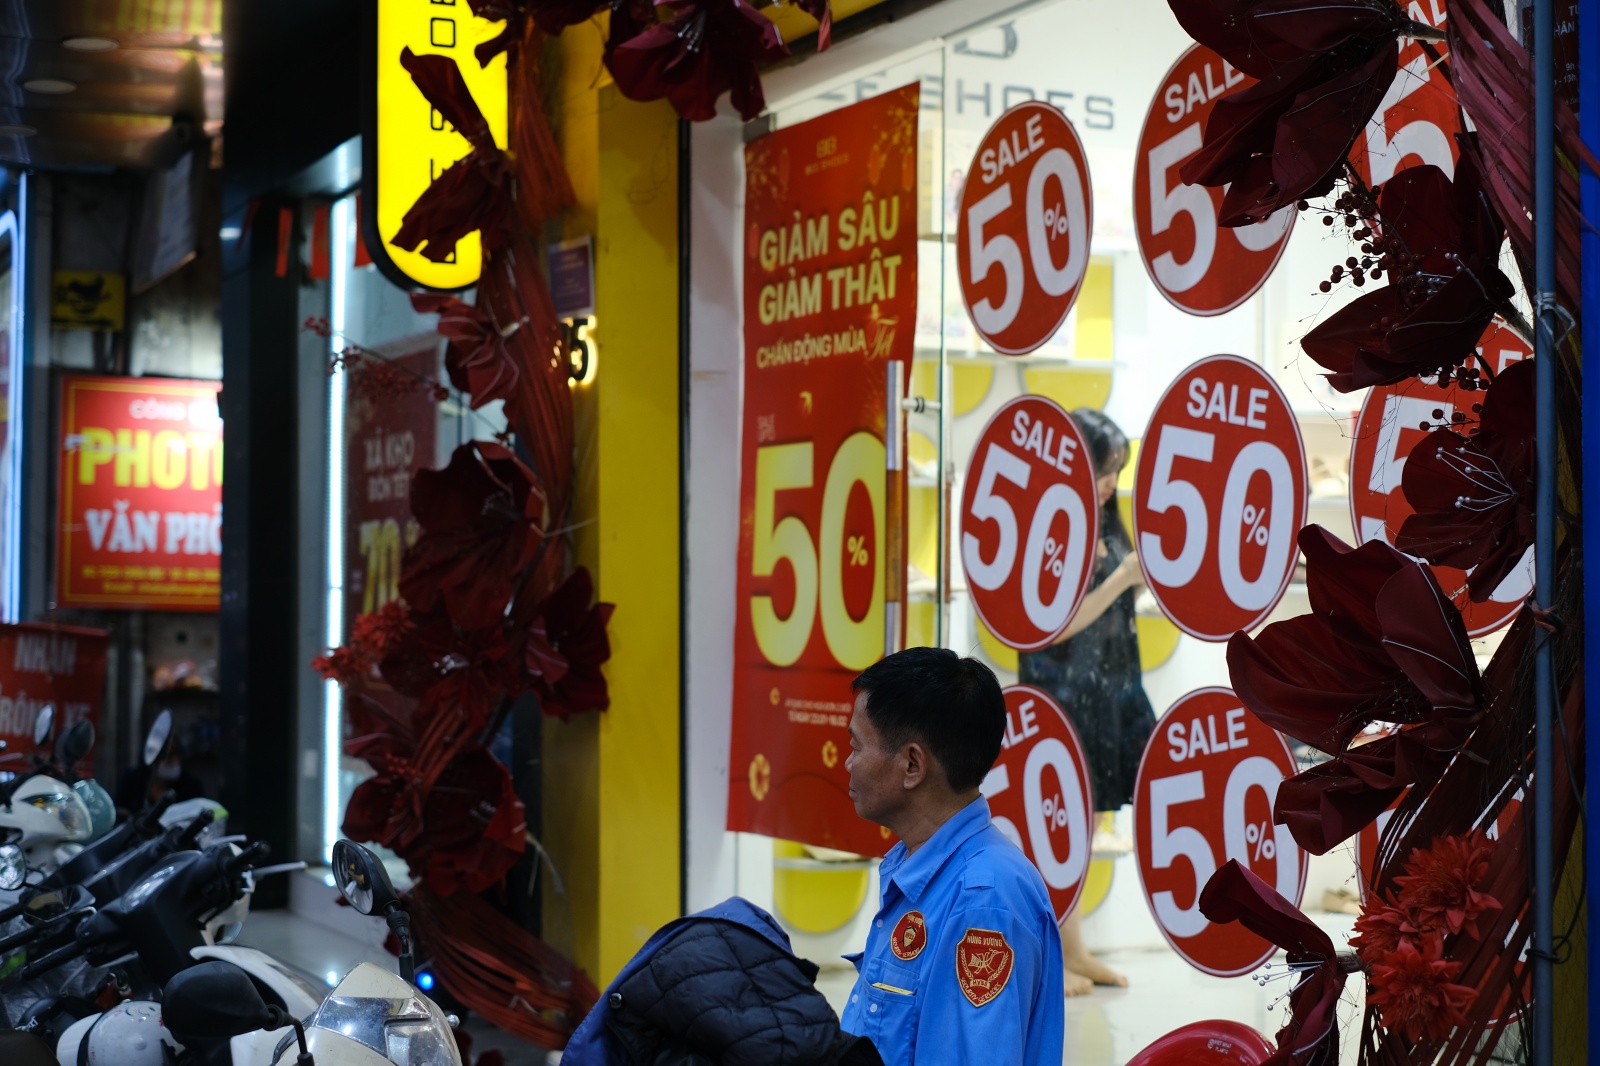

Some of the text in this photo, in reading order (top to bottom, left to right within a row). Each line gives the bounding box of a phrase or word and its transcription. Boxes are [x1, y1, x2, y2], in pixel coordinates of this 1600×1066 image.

[980, 113, 1045, 184] SALE
[759, 190, 900, 272] GIẢM SÂU
[758, 267, 823, 325] GIẢM
[1187, 377, 1271, 430] SALE
[1010, 409, 1078, 476] SALE
[85, 498, 160, 553] VĂN
[1167, 708, 1249, 762] SALE
